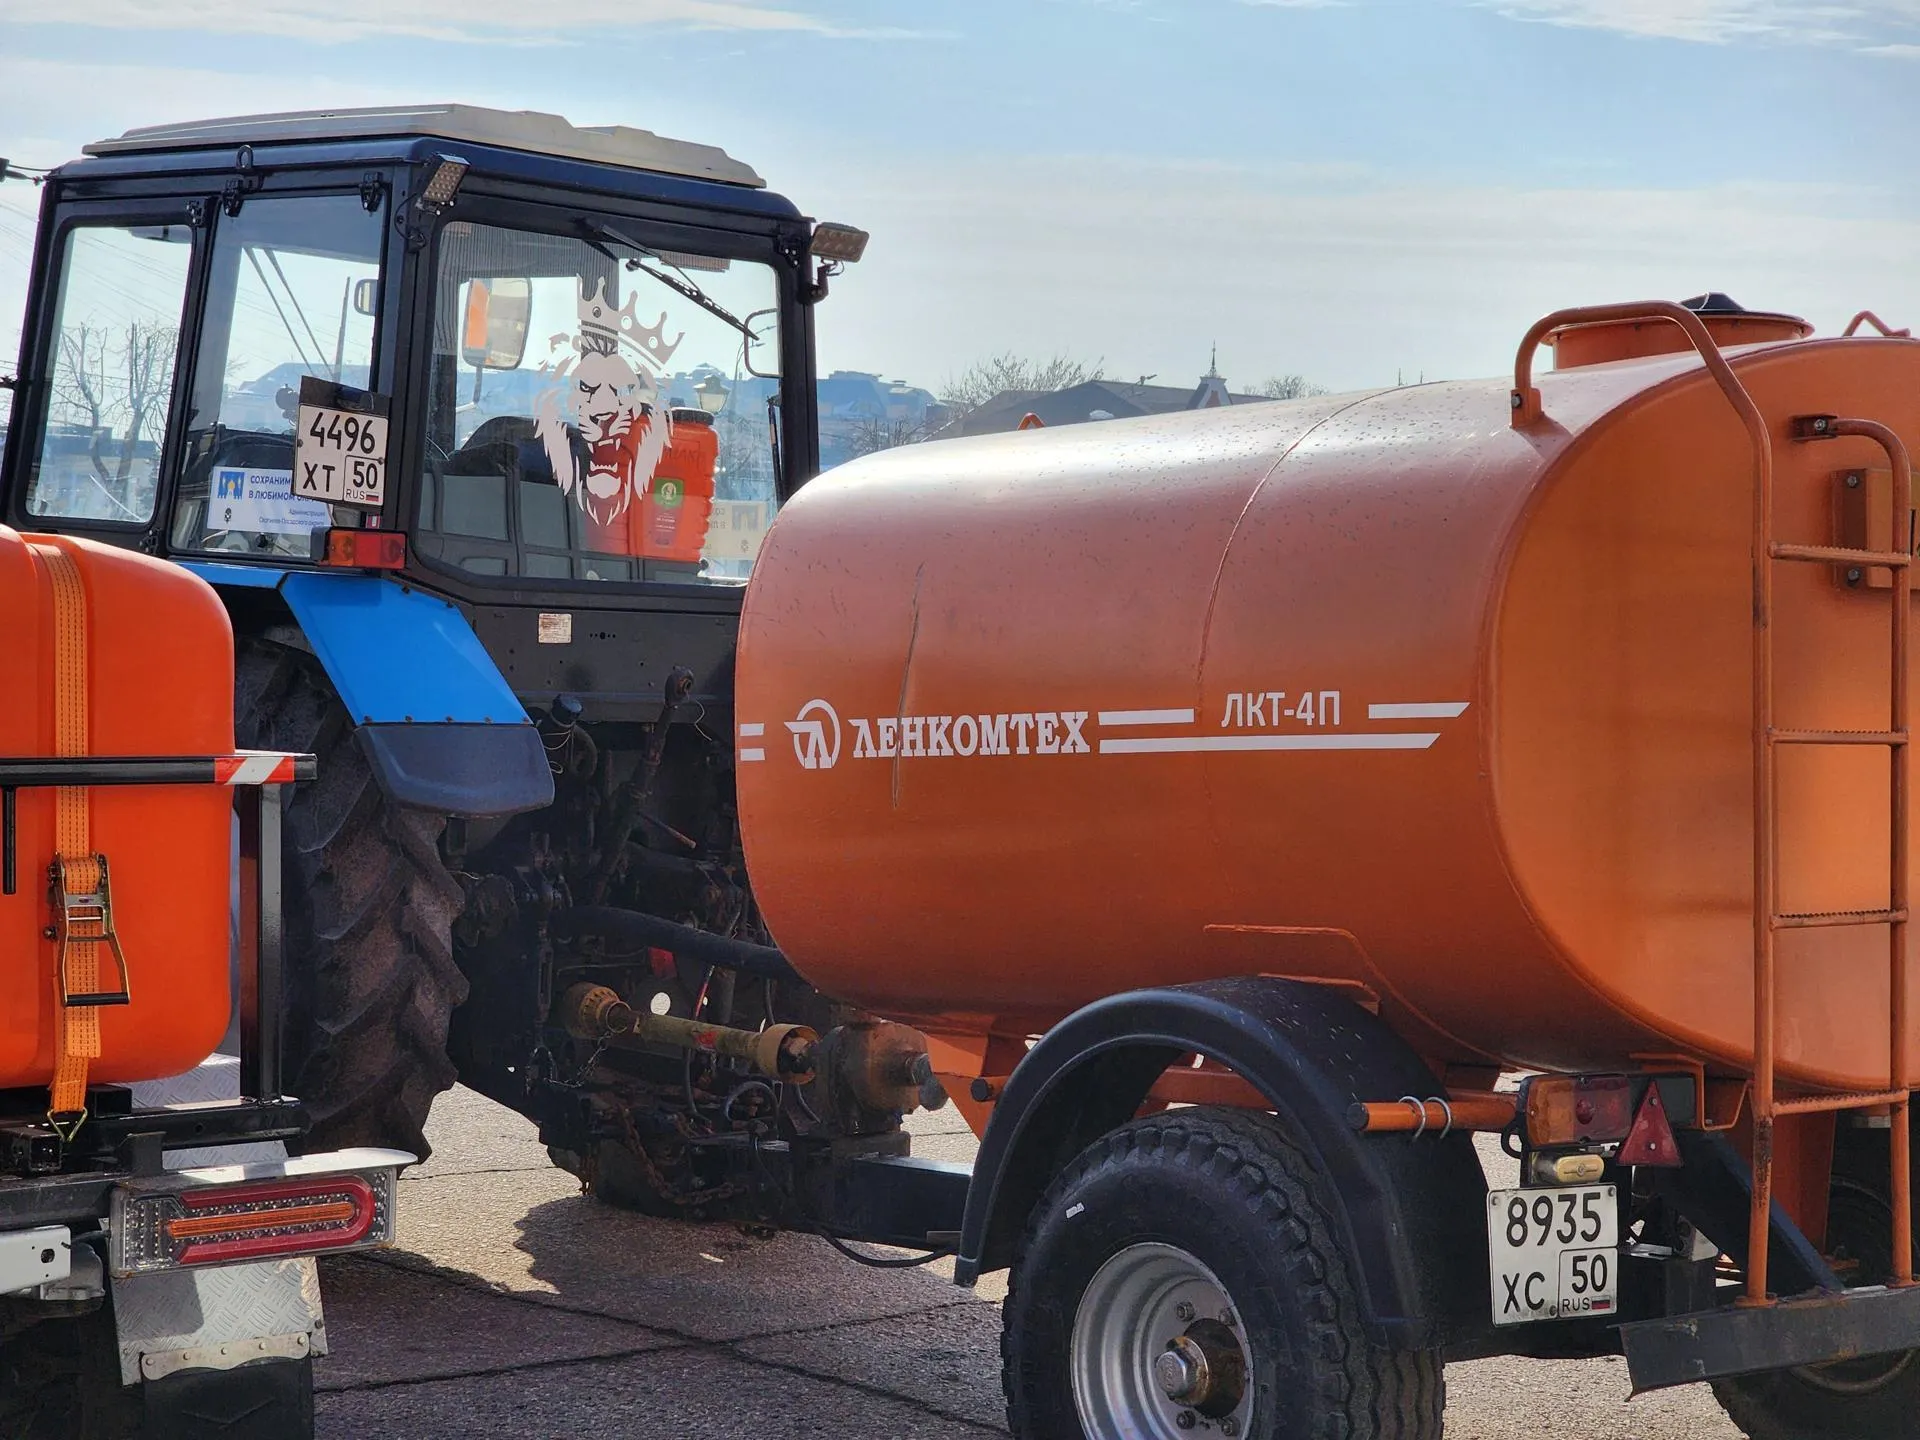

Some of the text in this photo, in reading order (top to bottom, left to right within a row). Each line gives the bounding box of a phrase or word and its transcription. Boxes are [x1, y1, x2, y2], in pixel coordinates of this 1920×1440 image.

[310, 412, 375, 454] 4496
[250, 475, 291, 486] СОХРАНИМ
[303, 461, 377, 492] ХТ 50
[249, 490, 254, 499] В
[346, 489, 365, 500] RUS
[1221, 690, 1340, 728] ЛКТ-4П
[848, 711, 1091, 759] ЛЕНКОМТЕХ
[1506, 1192, 1601, 1247] 8935
[1503, 1254, 1608, 1314] ХС 50
[1562, 1297, 1590, 1312] RUS
